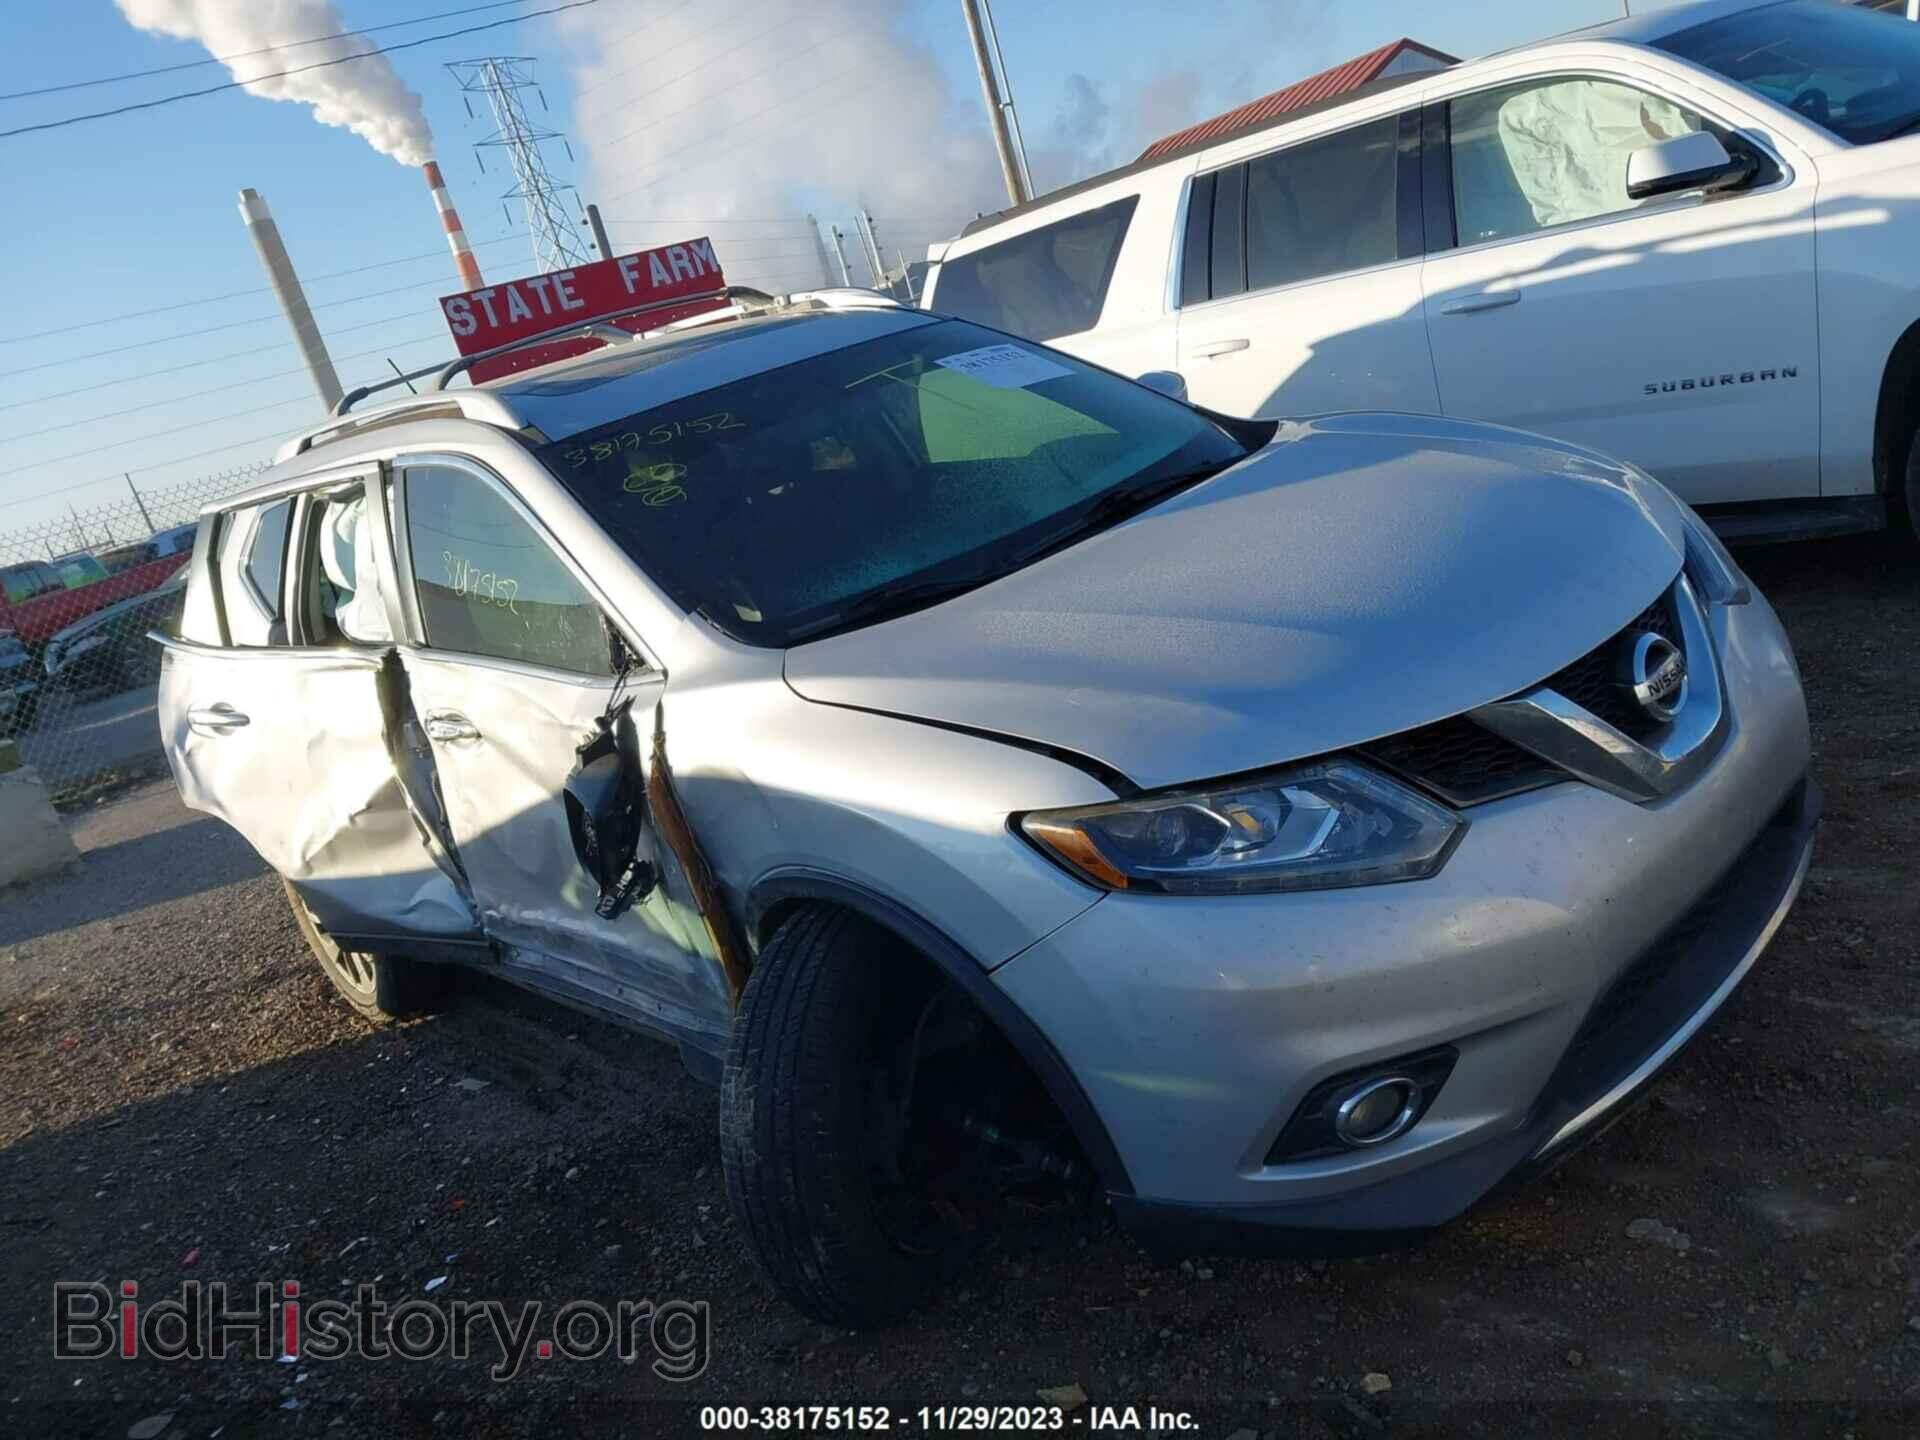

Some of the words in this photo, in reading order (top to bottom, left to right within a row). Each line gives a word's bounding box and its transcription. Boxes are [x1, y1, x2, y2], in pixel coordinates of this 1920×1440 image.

[445, 272, 585, 336] STATE
[617, 239, 719, 295] FARM
[1643, 366, 1799, 396] SUBURBAN
